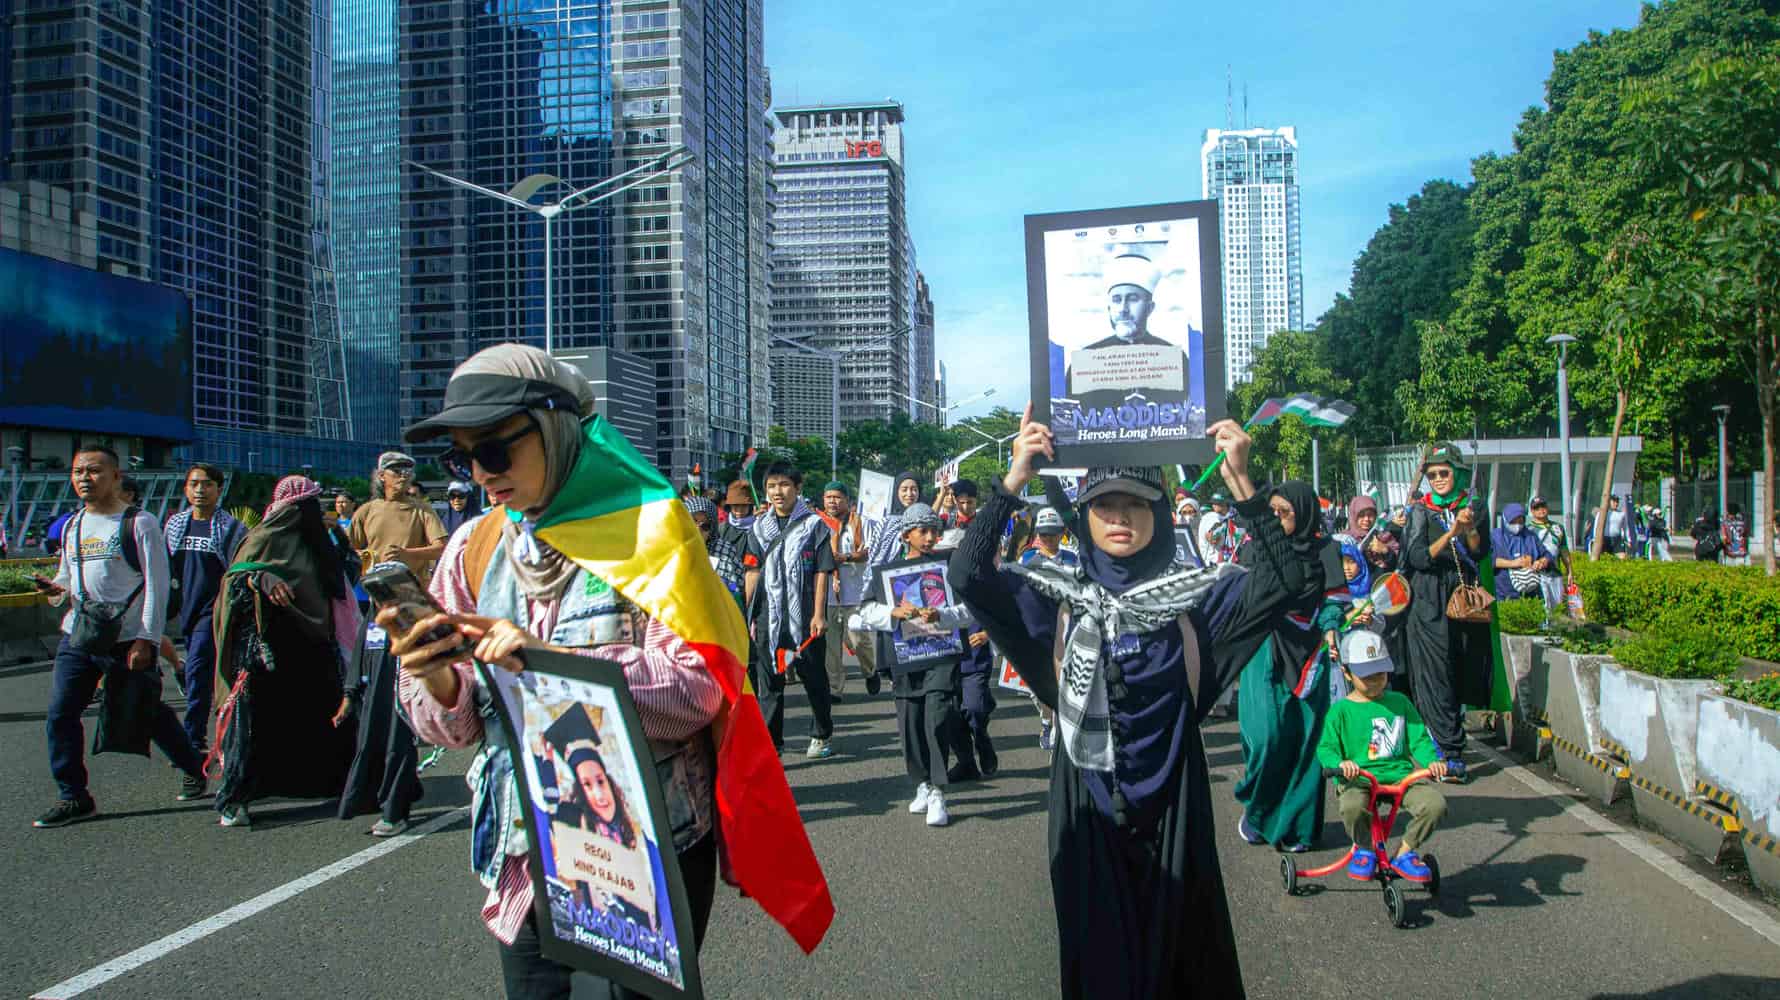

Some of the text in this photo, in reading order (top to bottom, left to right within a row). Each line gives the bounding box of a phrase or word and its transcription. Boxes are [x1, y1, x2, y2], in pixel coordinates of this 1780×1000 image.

[1078, 424, 1188, 441] Heroes Long March
[574, 924, 669, 977] Heroes Long March
